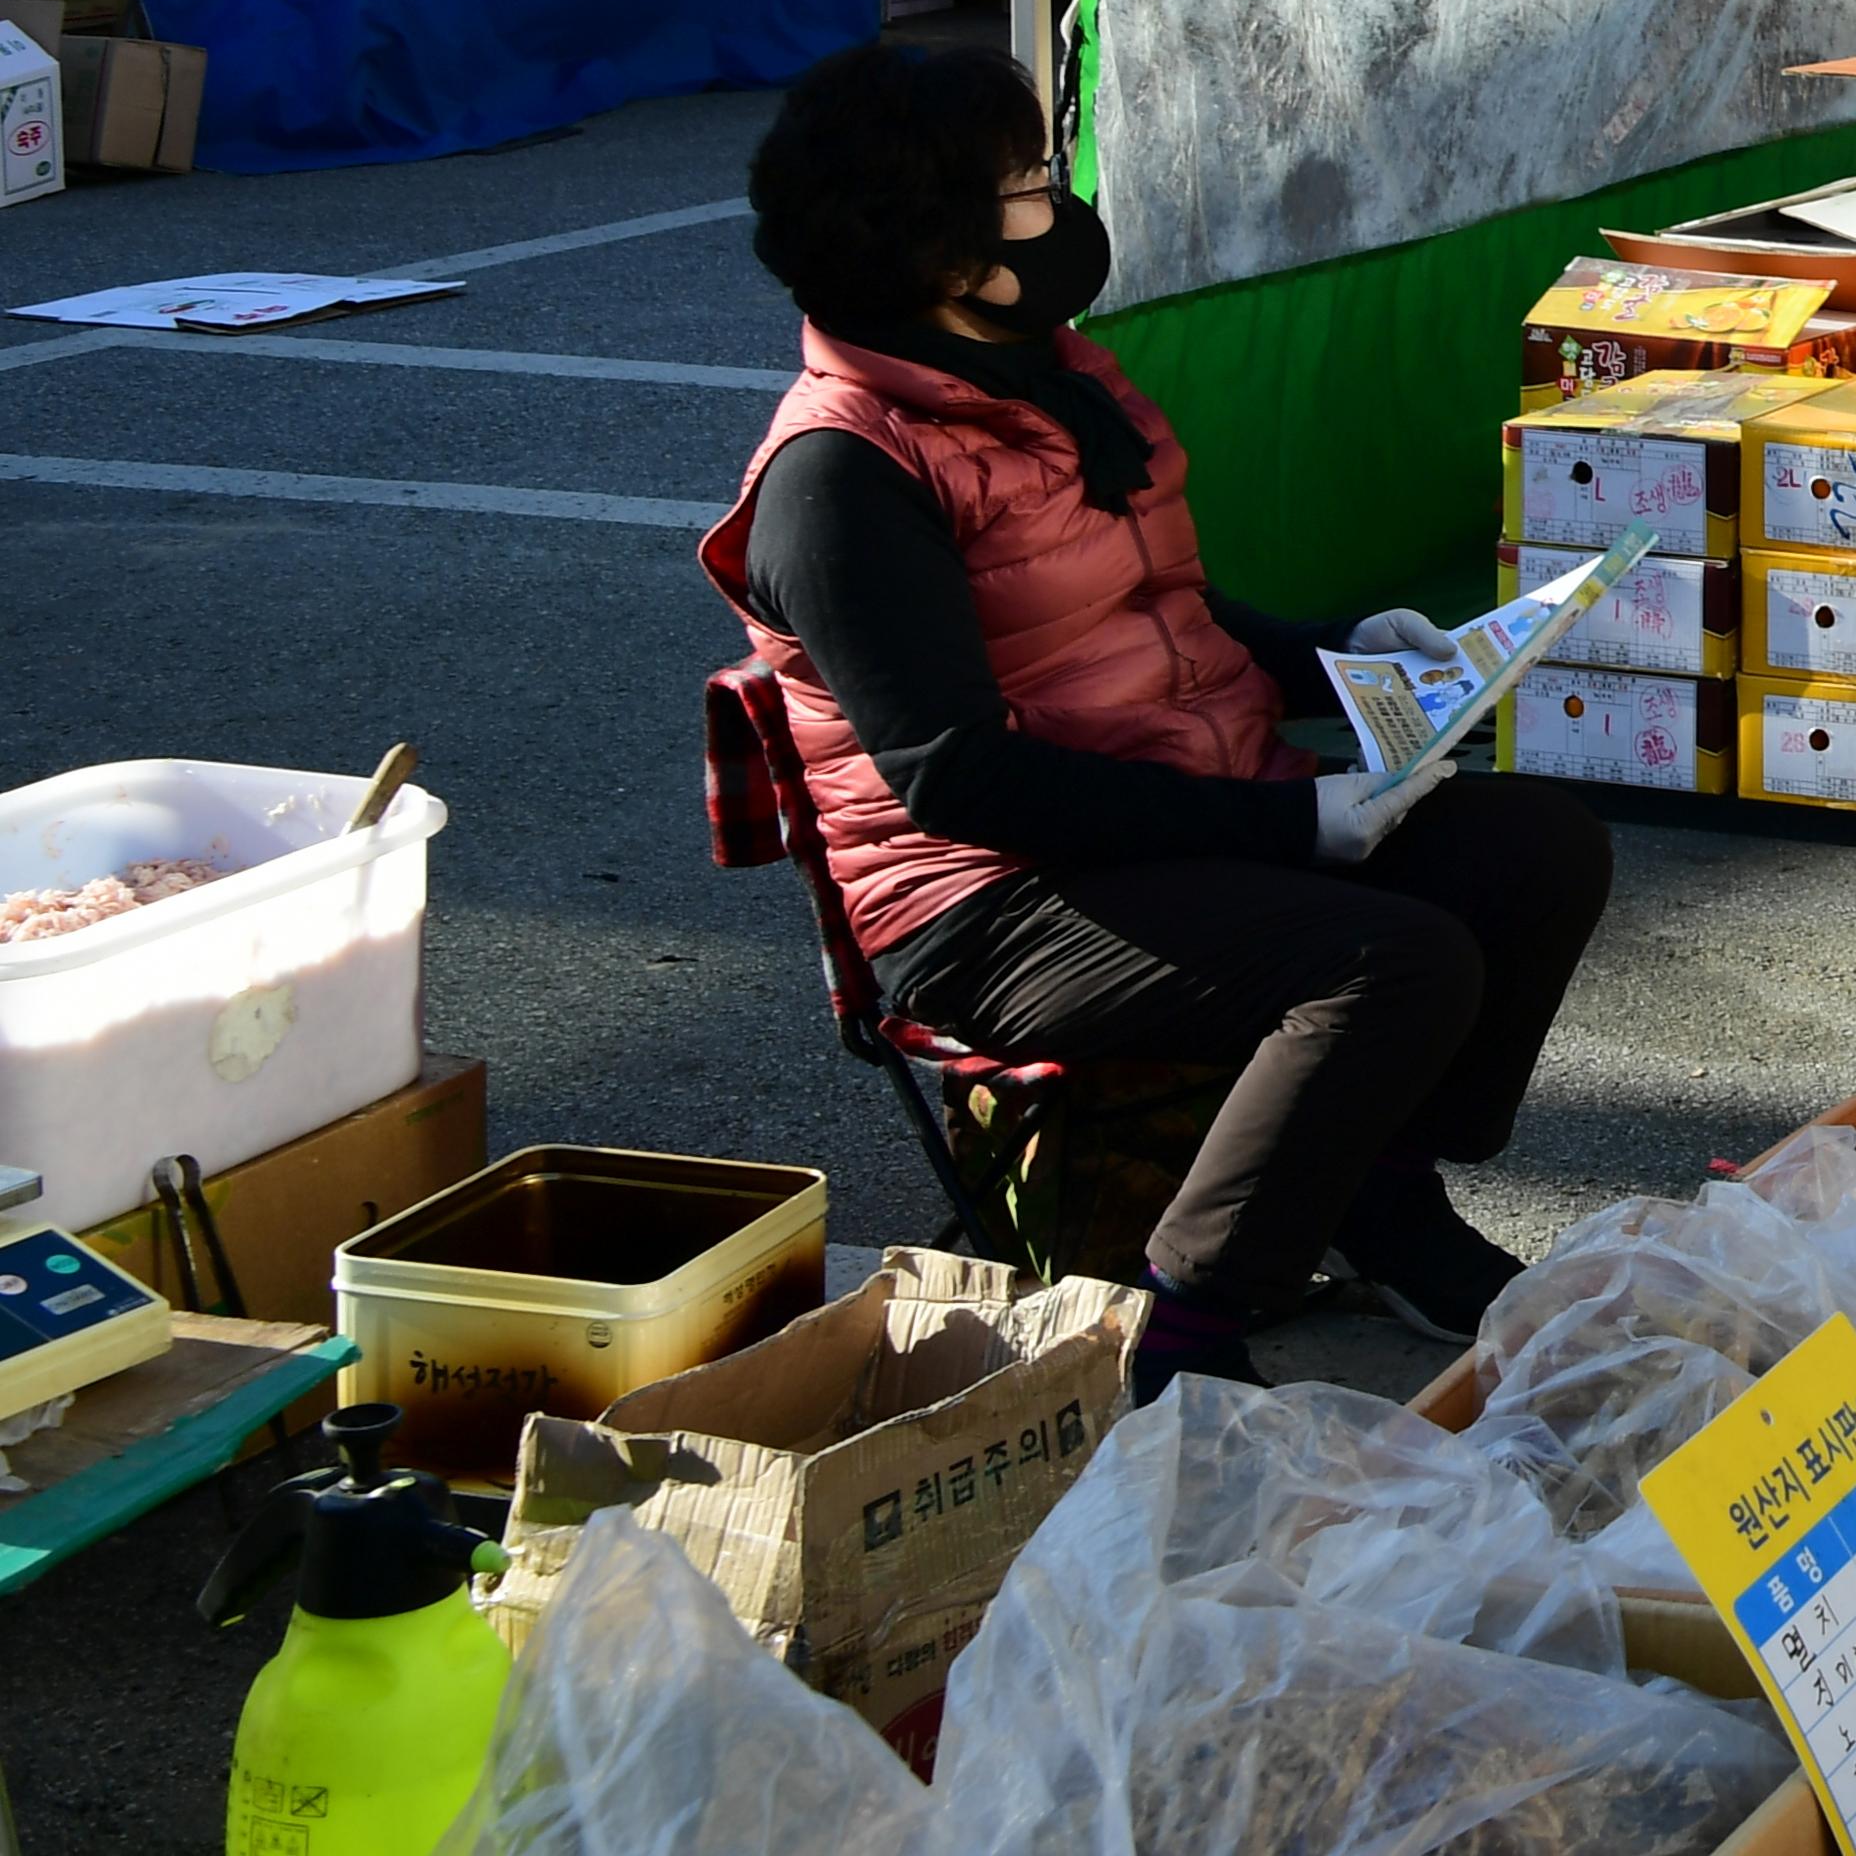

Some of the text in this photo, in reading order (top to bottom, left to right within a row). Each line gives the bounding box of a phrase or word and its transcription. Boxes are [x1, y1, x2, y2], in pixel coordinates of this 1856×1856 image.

[16, 125, 42, 149] 숙주
[1594, 477, 1606, 502] L
[1776, 467, 1802, 489] 2L
[1634, 481, 1667, 518] 조생
[1643, 688, 1678, 722] 조생
[913, 1420, 1051, 1523] 취급주의
[1729, 1456, 1811, 1551] 원산지
